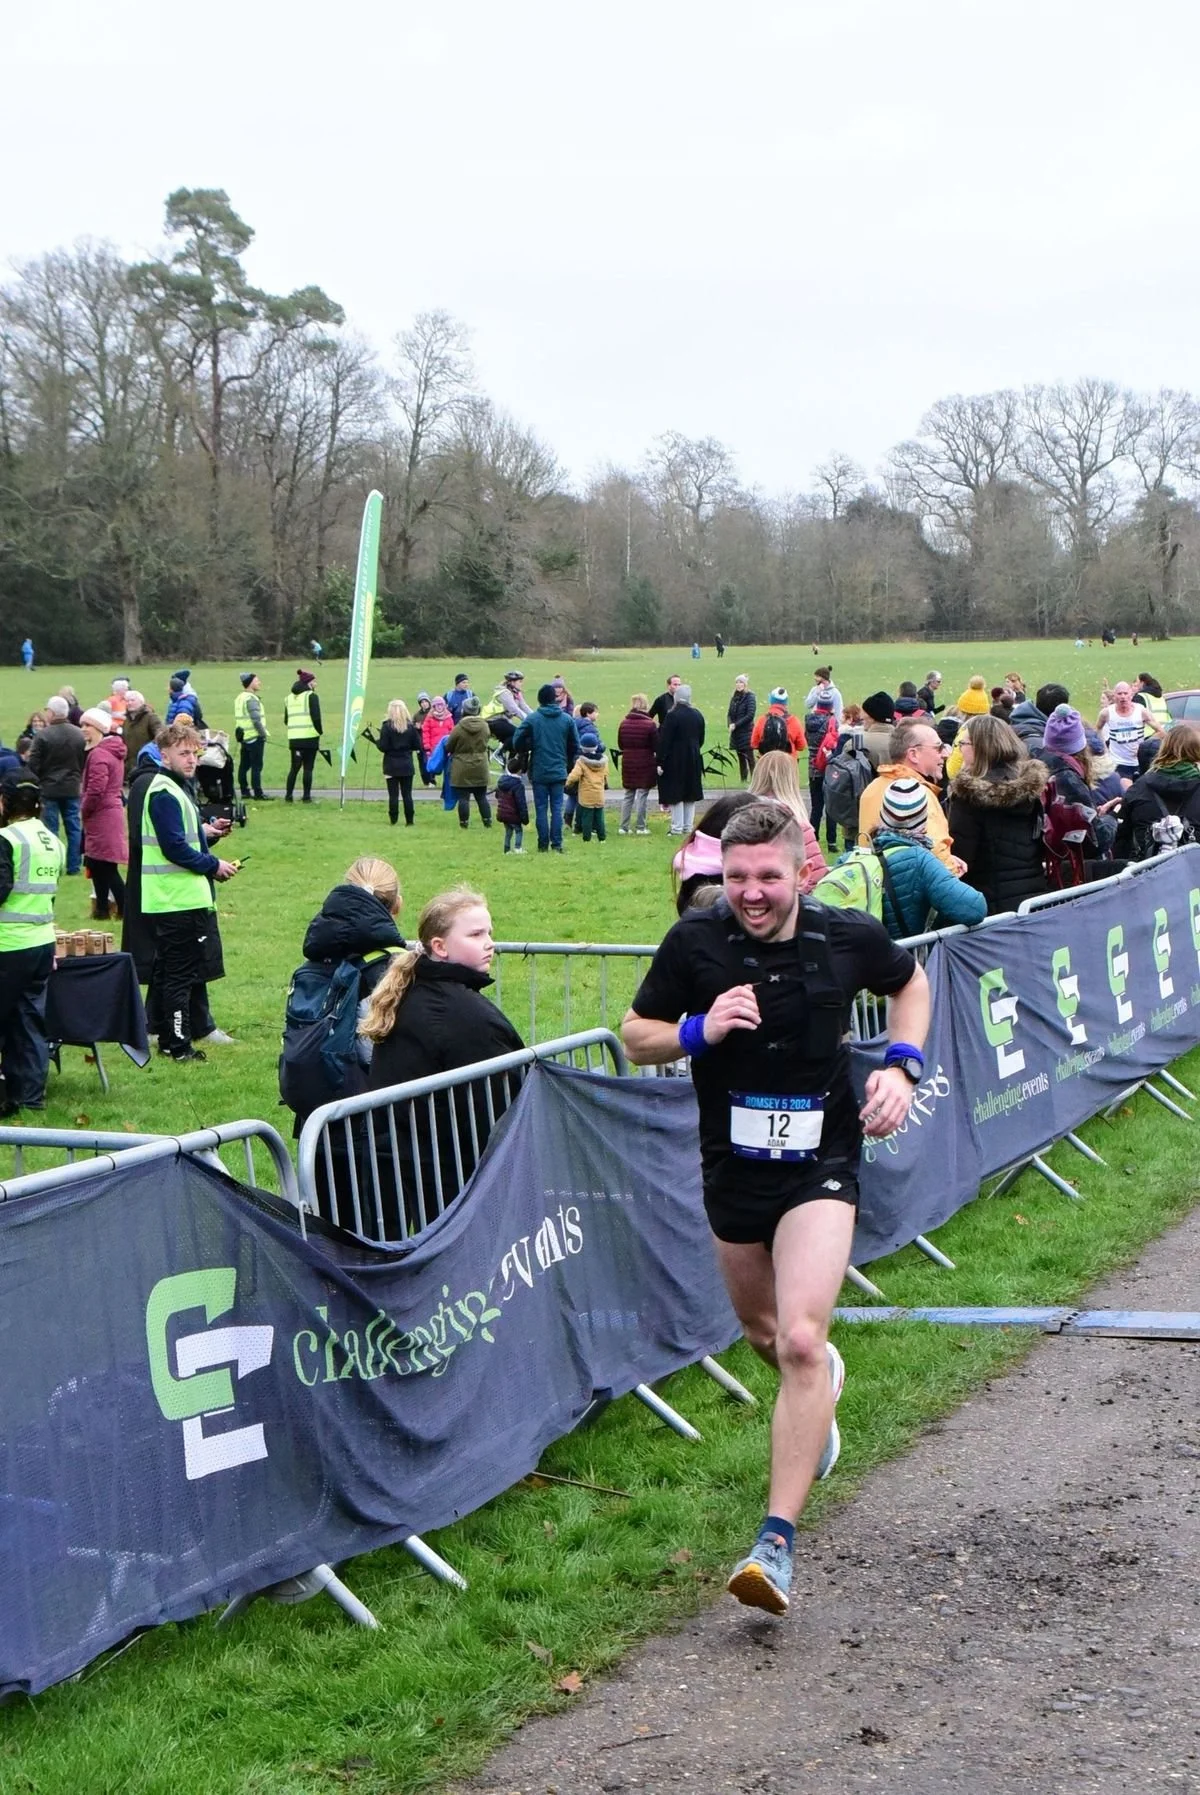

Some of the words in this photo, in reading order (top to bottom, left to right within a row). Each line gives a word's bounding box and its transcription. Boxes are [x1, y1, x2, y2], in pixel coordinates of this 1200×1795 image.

[356, 621, 366, 687] HAMPSHIRE
[744, 1096, 780, 1109] ROMSEY
[781, 1098, 788, 1109] 5
[789, 1098, 812, 1110] 2024
[767, 1113, 791, 1138] 12
[767, 1139, 786, 1147] ADAM
